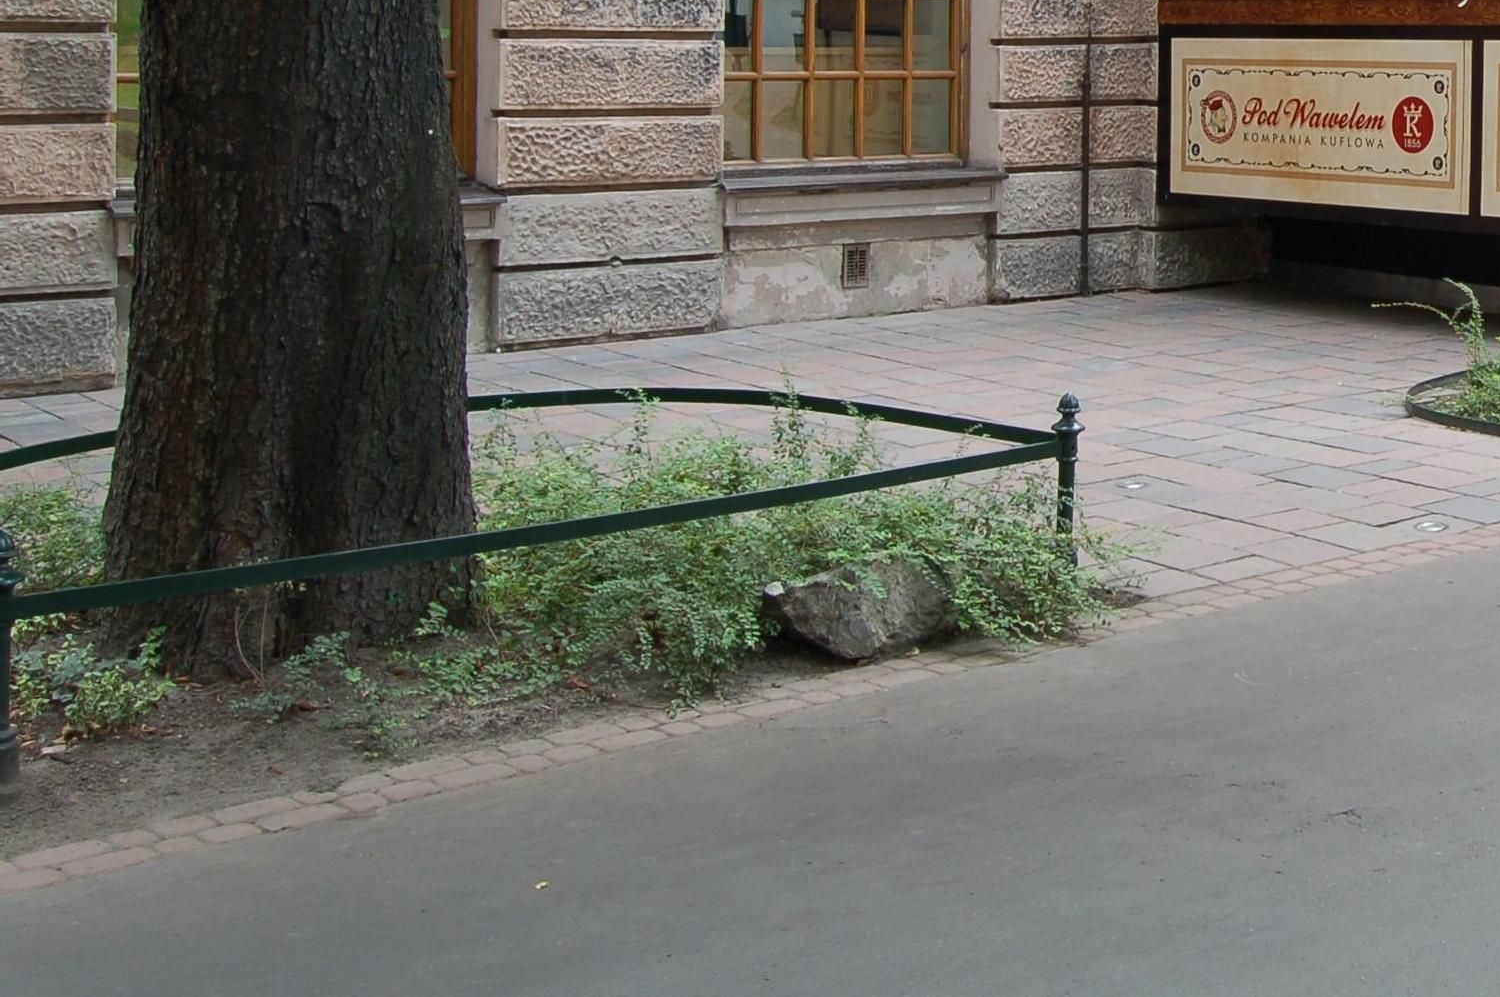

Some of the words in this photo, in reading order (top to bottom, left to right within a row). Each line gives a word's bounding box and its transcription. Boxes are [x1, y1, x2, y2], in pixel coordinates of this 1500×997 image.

[1242, 96, 1284, 127] Pod
[1284, 97, 1387, 131] Wawelem
[1242, 131, 1312, 146] KOMPANIA
[1320, 133, 1385, 149] KUFLOWA
